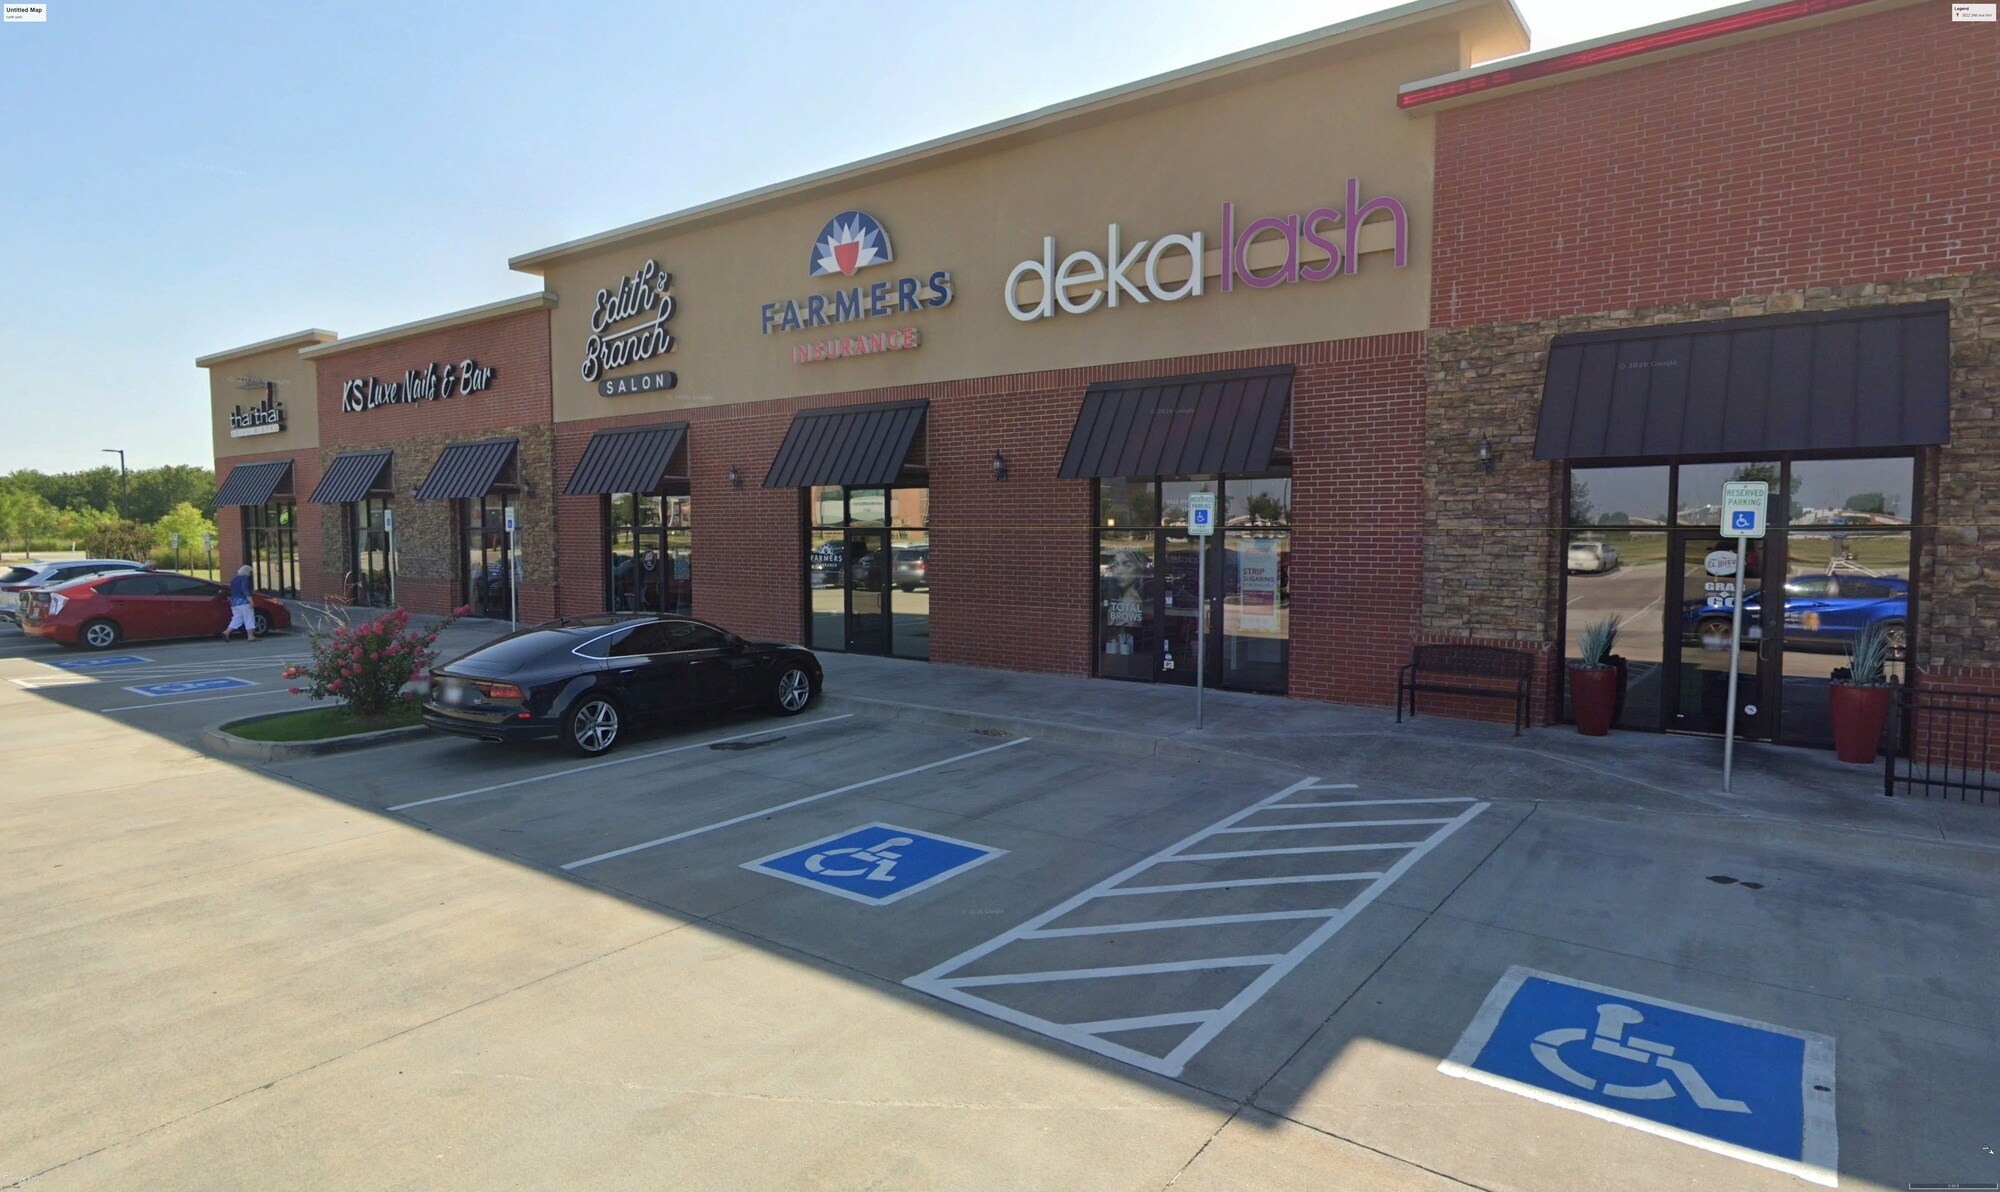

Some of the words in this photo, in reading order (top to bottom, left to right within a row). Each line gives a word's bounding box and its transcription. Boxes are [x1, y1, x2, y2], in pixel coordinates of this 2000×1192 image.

[1004, 223, 1204, 321] deka
[1220, 176, 1408, 294] lash
[591, 259, 655, 333] Edith
[657, 271, 668, 292] &
[761, 270, 951, 336] FARMERS
[581, 295, 672, 383] Branch
[790, 327, 919, 363] INSURANCE
[341, 378, 364, 412] KS
[367, 377, 398, 409] Luxe
[401, 363, 437, 403] Nails
[441, 365, 455, 398] &
[459, 359, 492, 396] Bar
[606, 374, 664, 395] SALON
[1726, 489, 1764, 497] RESERVED
[810, 554, 843, 562] FARMERS
[1718, 559, 1737, 568] HUEV
[1242, 567, 1265, 576] STRIP
[1704, 582, 1746, 592] GRA
[1110, 602, 1143, 613] TOTAL
[1110, 611, 1143, 622] BROWS
